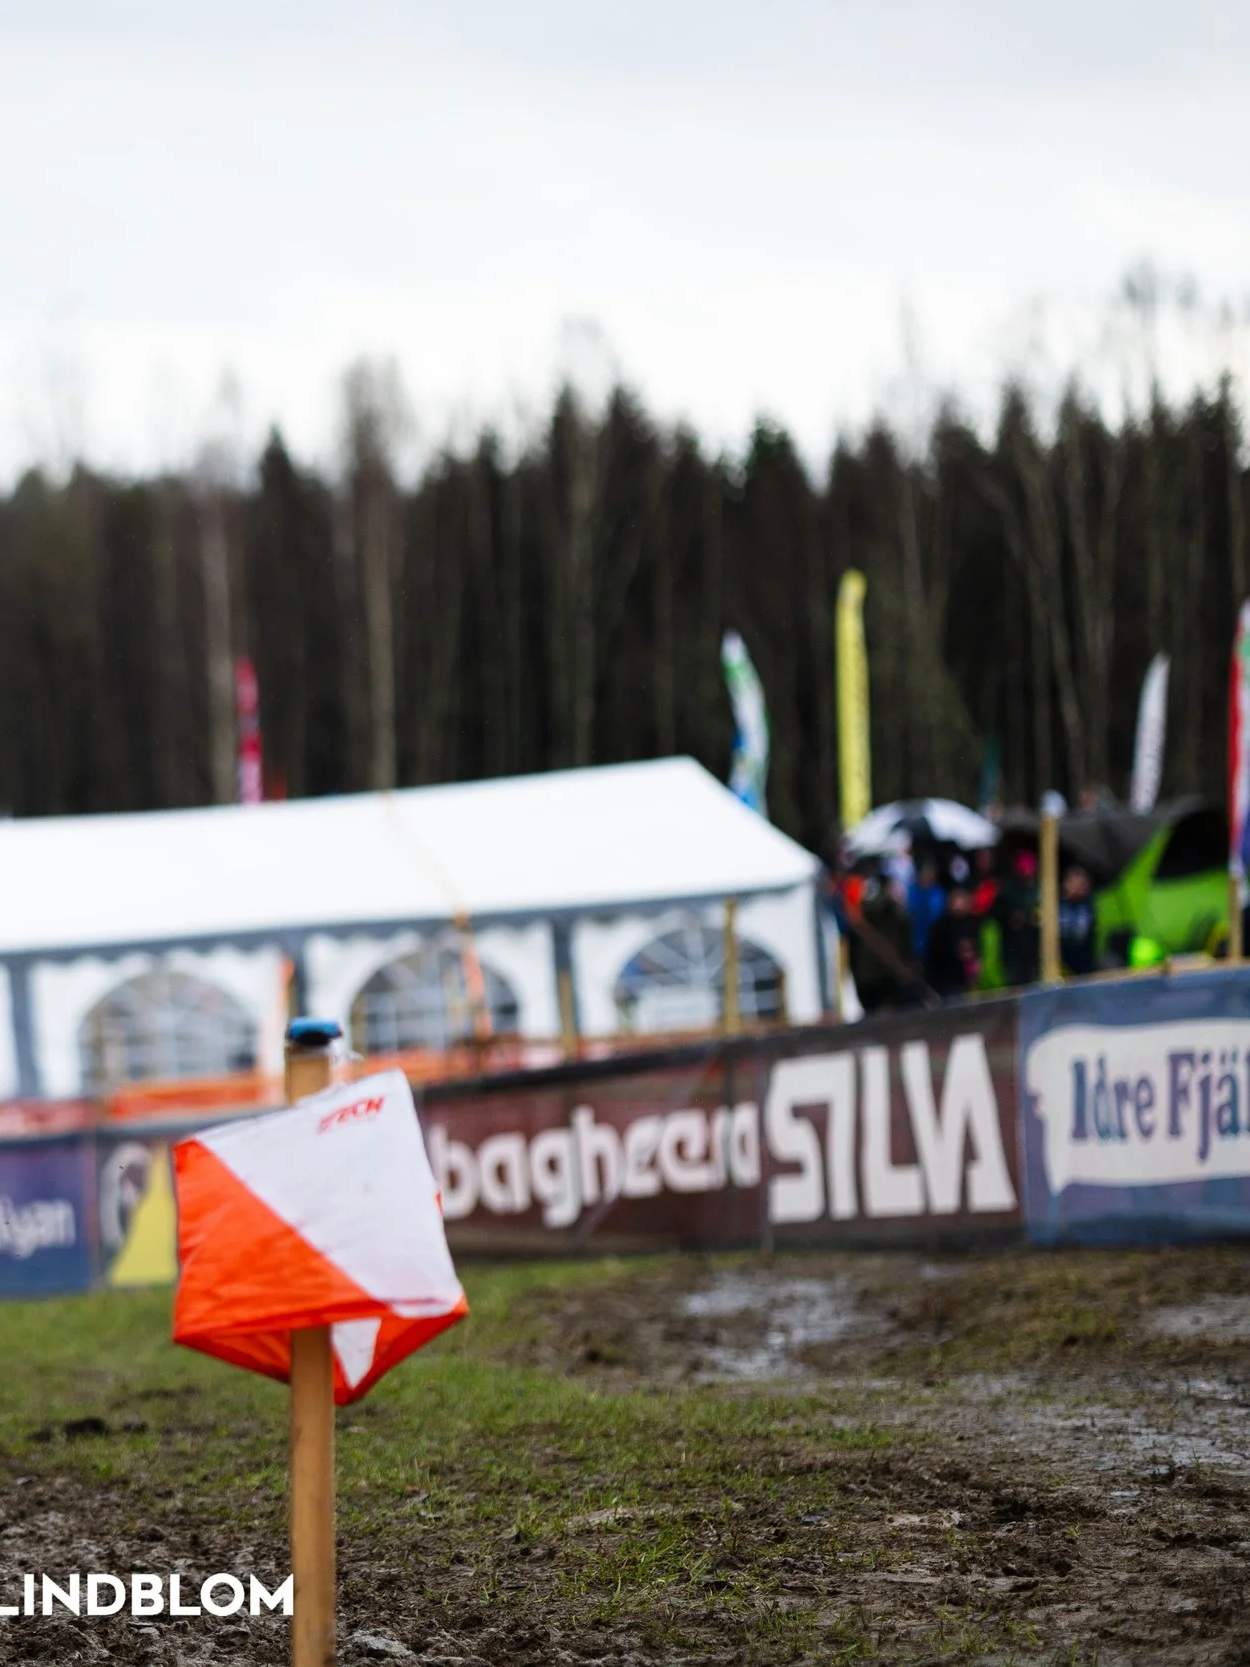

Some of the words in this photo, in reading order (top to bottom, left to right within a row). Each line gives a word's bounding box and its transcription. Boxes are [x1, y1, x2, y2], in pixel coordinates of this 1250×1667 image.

[766, 1033, 1016, 1225] SILVA
[1072, 1056, 1156, 1140] Idre
[431, 1104, 761, 1228] bagheera
